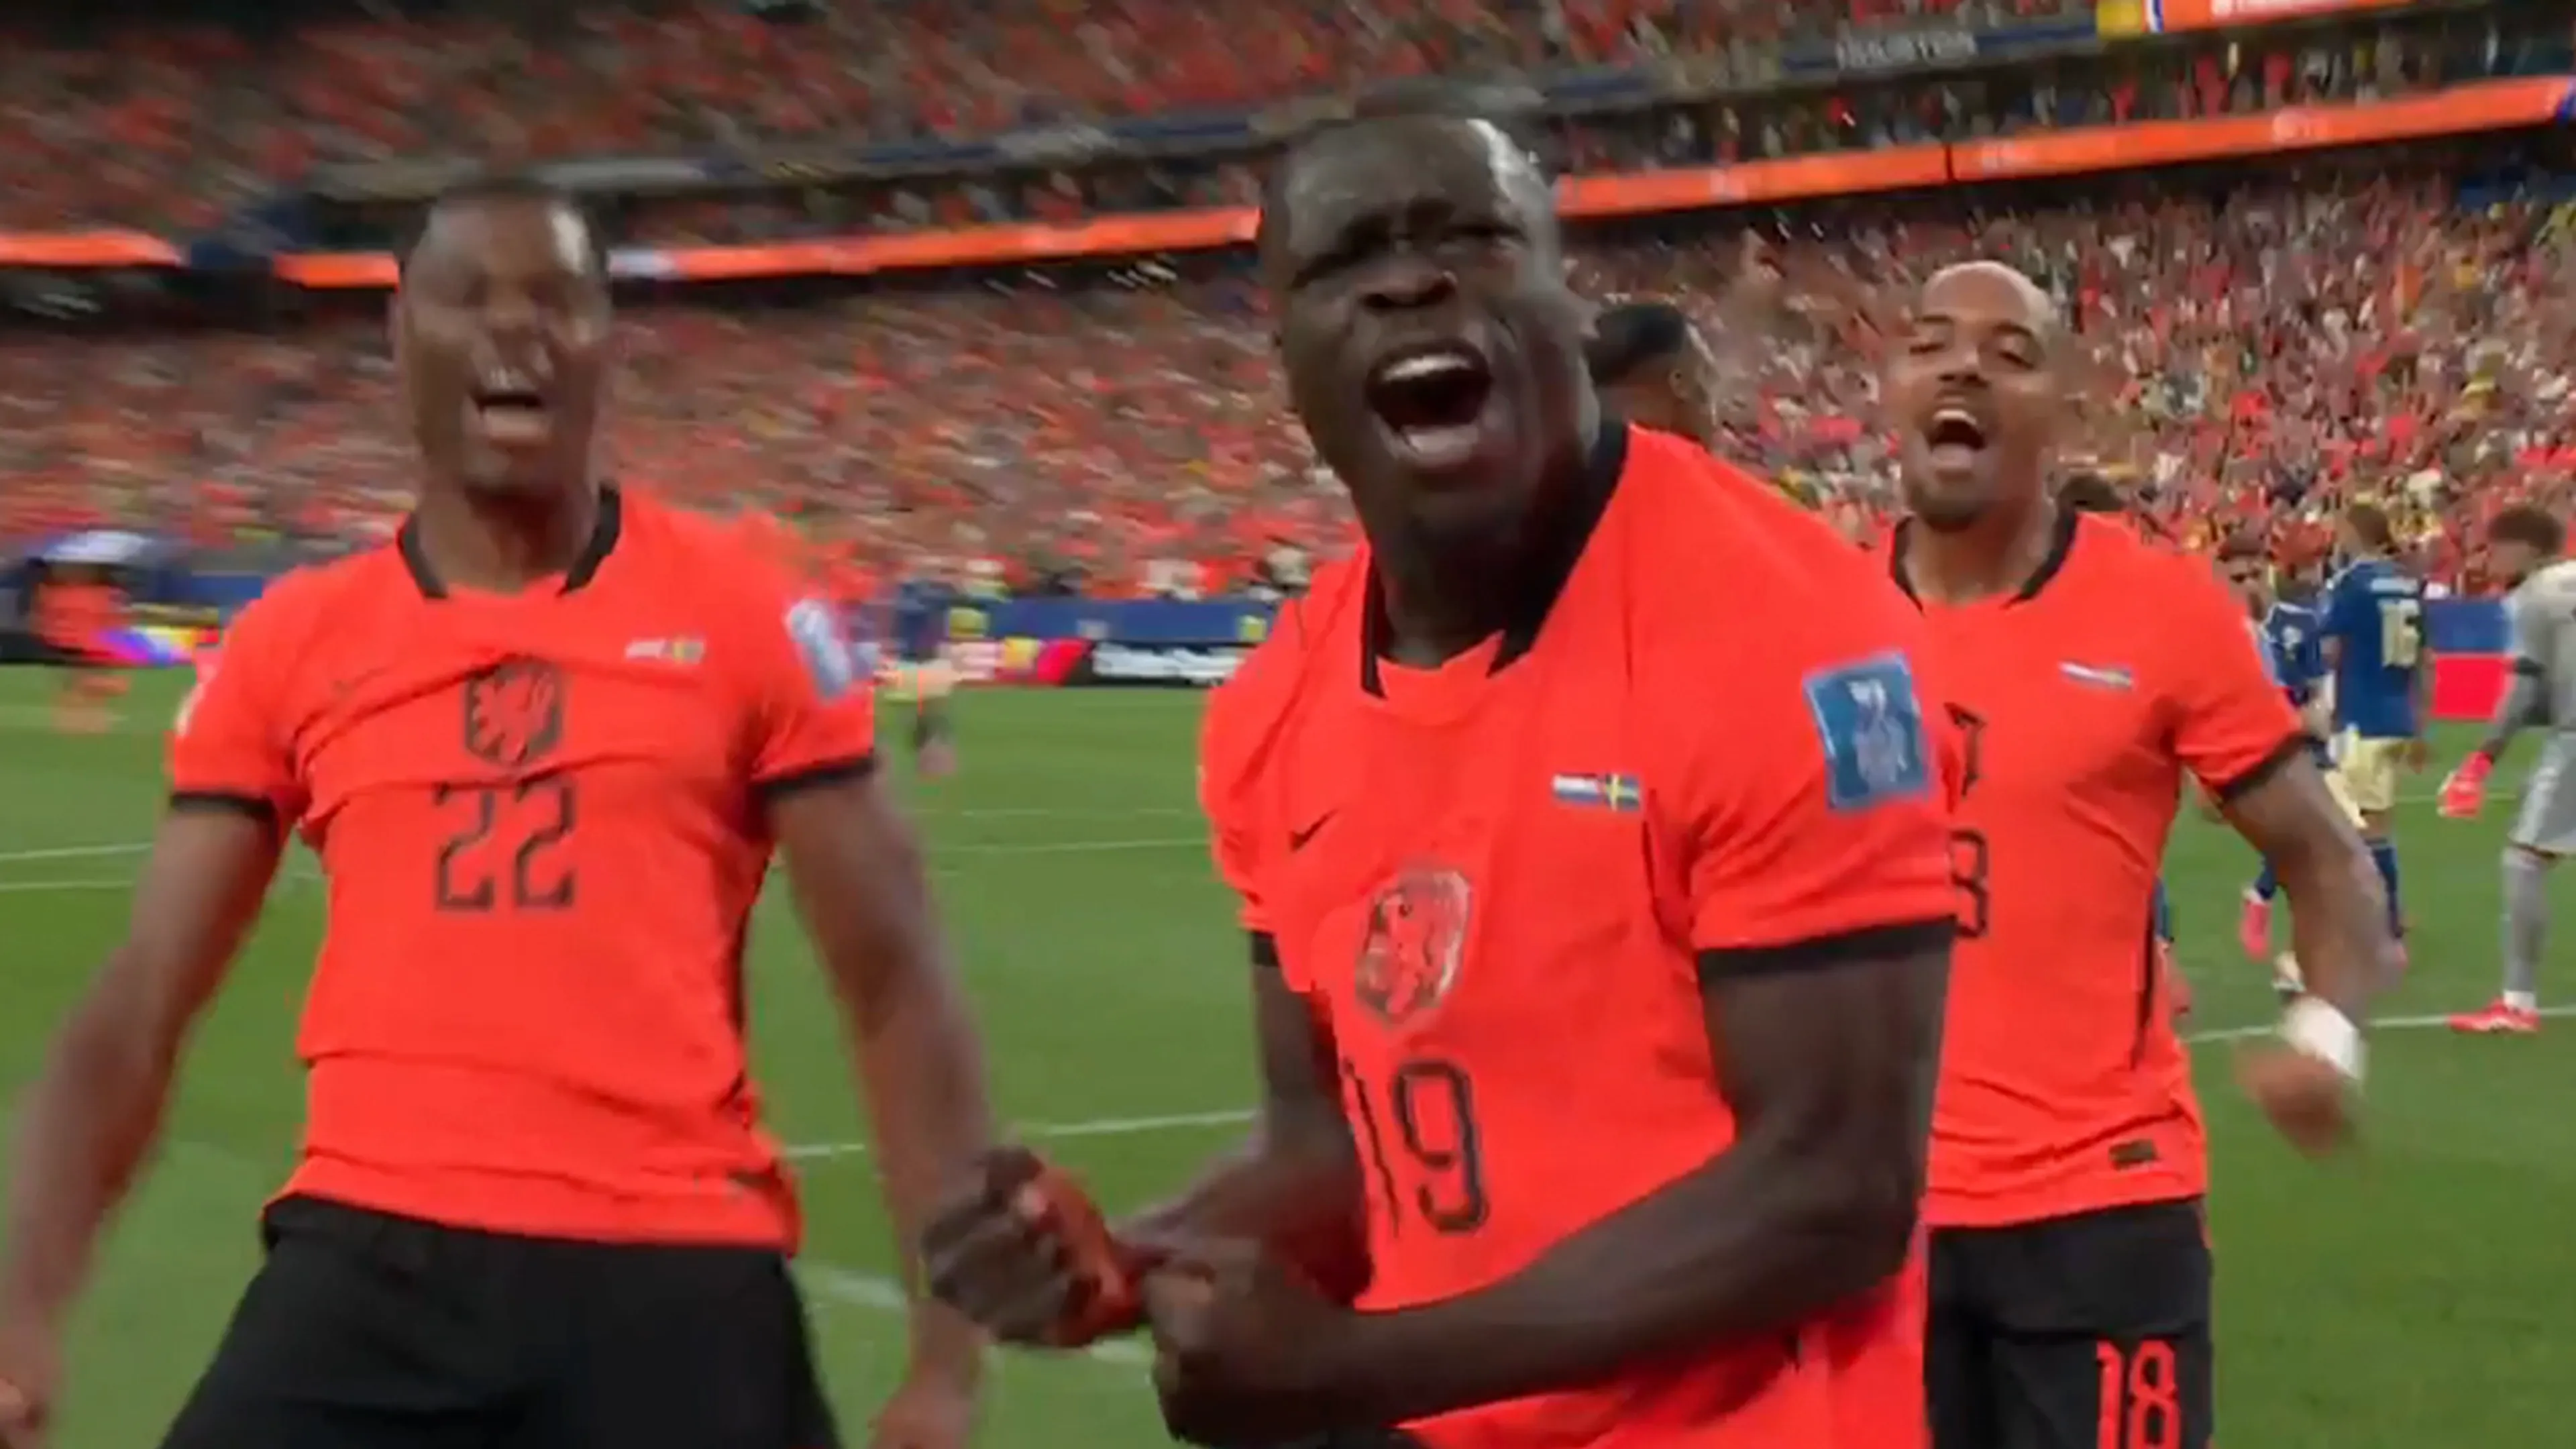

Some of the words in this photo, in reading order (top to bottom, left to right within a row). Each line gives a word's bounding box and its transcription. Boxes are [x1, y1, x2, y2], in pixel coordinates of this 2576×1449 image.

[433, 771, 576, 911] 22
[1344, 1057, 1492, 1236] 19
[2096, 1340, 2180, 1449] 18
